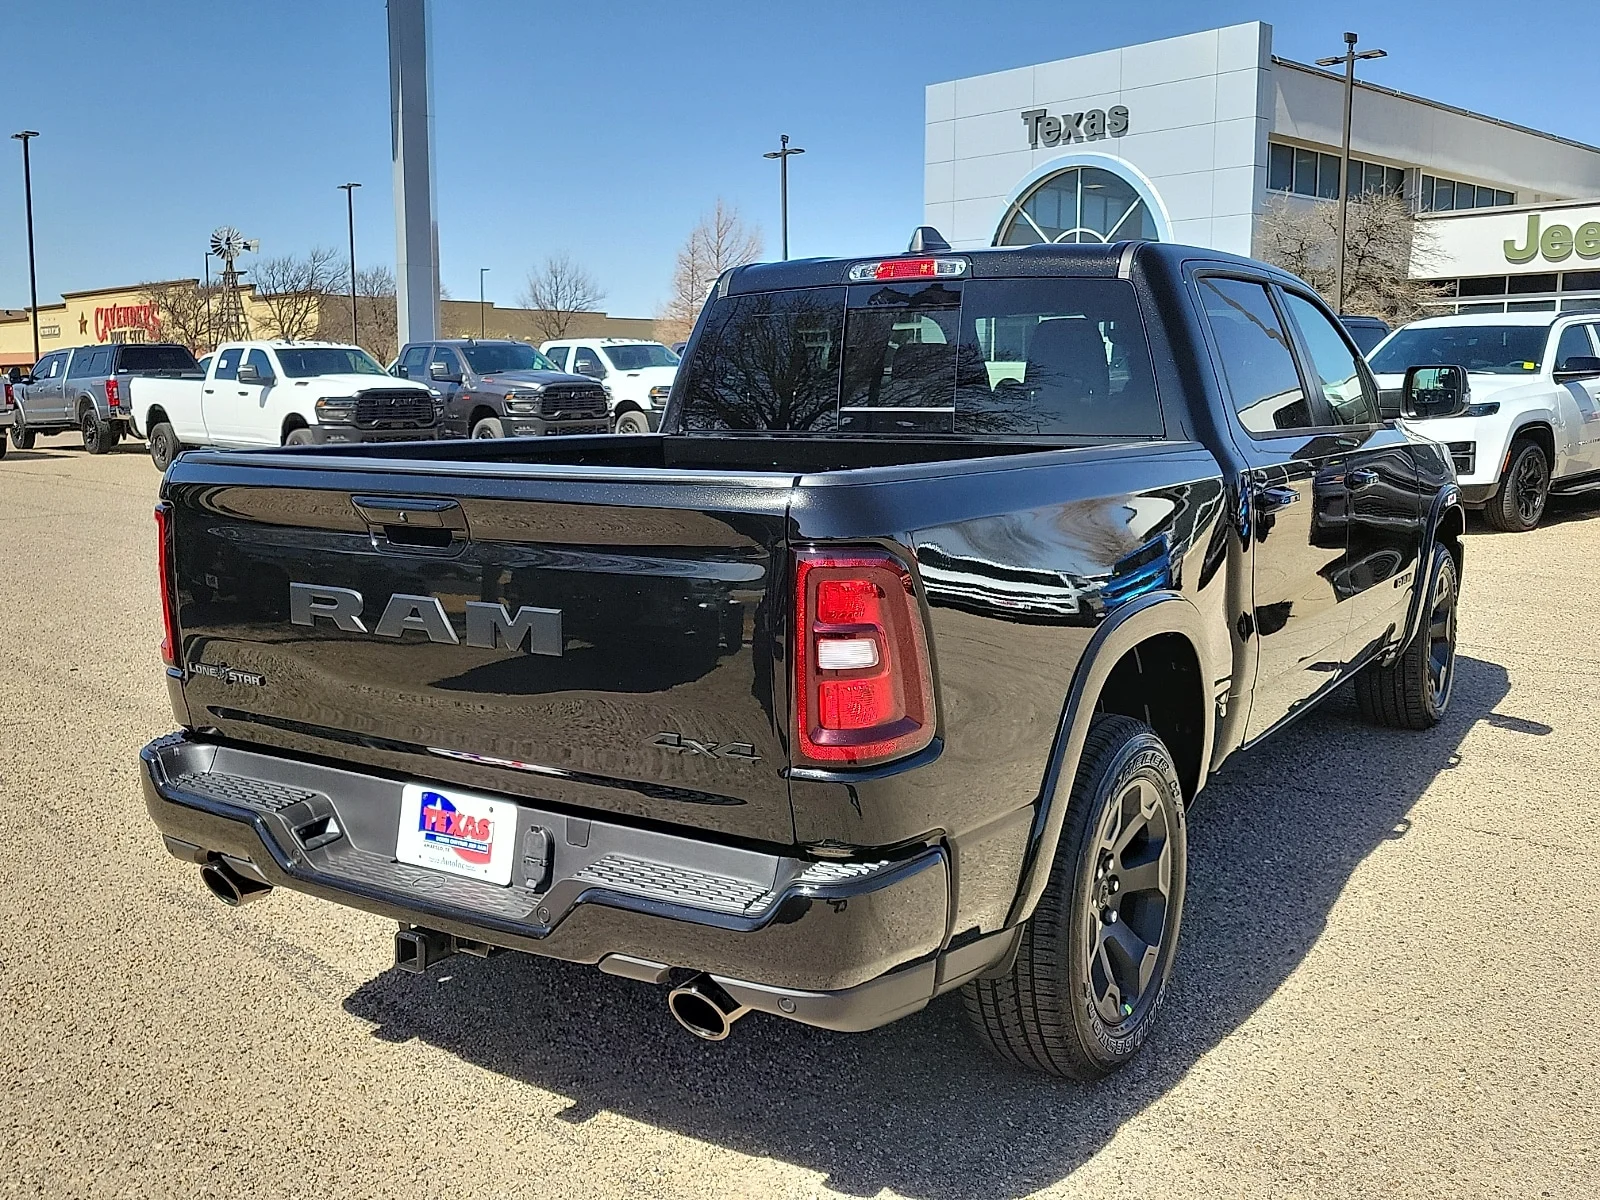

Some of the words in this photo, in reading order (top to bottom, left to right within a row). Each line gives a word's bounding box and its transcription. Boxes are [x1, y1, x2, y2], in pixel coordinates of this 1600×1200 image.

[1021, 105, 1129, 149] Texas
[289, 582, 563, 657] RAM
[188, 662, 218, 677] LONE
[229, 671, 261, 686] STAR
[423, 806, 490, 841] TEXAS
[1083, 979, 1166, 1055] BRIDGESTONE
